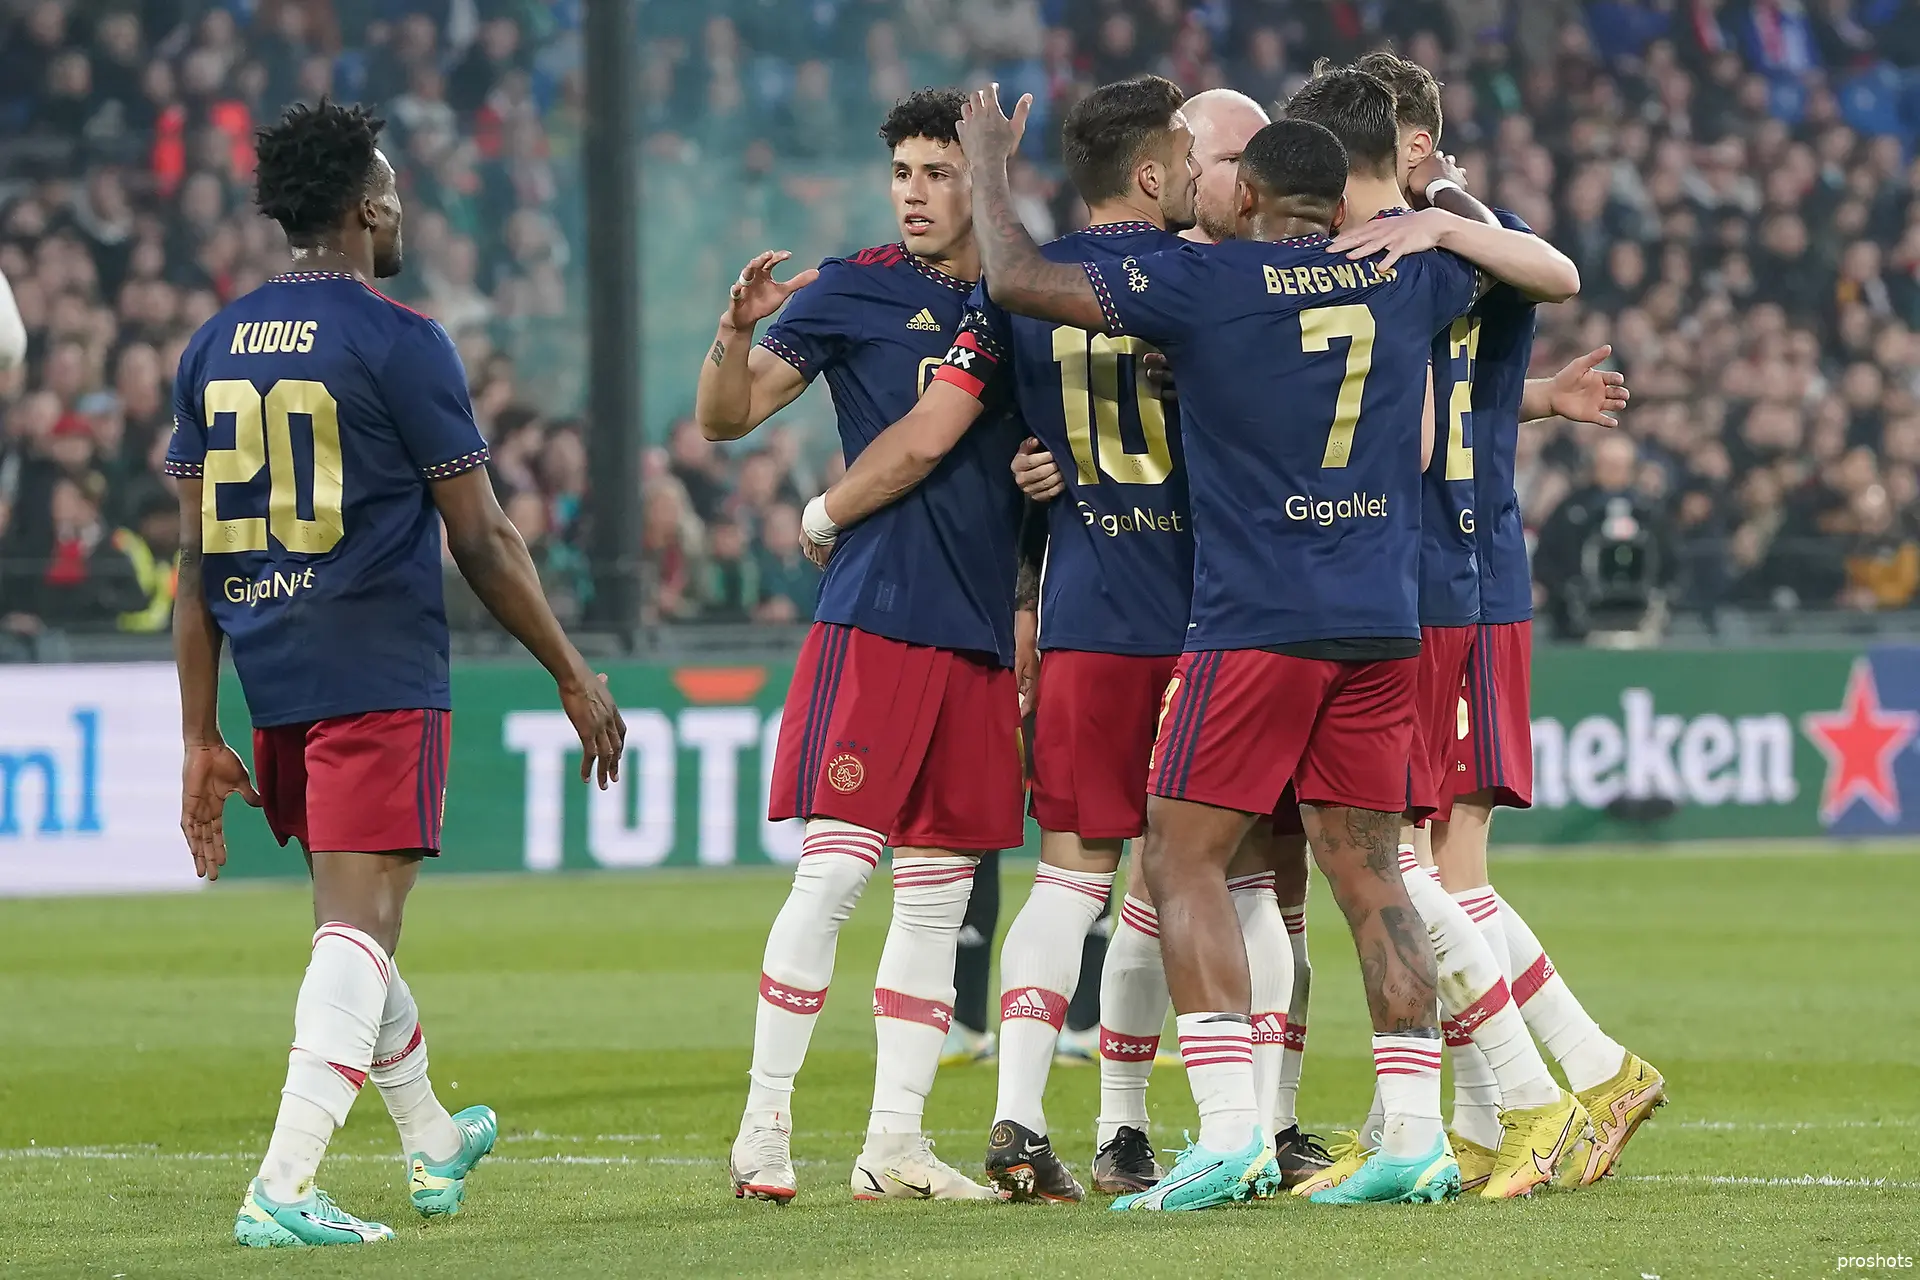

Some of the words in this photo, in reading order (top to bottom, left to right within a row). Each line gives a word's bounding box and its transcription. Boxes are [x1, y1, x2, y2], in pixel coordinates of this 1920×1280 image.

[230, 320, 318, 354] KUDUS
[906, 322, 941, 332] adidas
[1299, 303, 1376, 469] 7
[1051, 324, 1174, 486] 10
[201, 378, 344, 554] 20
[1076, 500, 1184, 538] GgaNet
[1285, 491, 1388, 526] GigaNet
[1003, 1003, 1051, 1022] adidas
